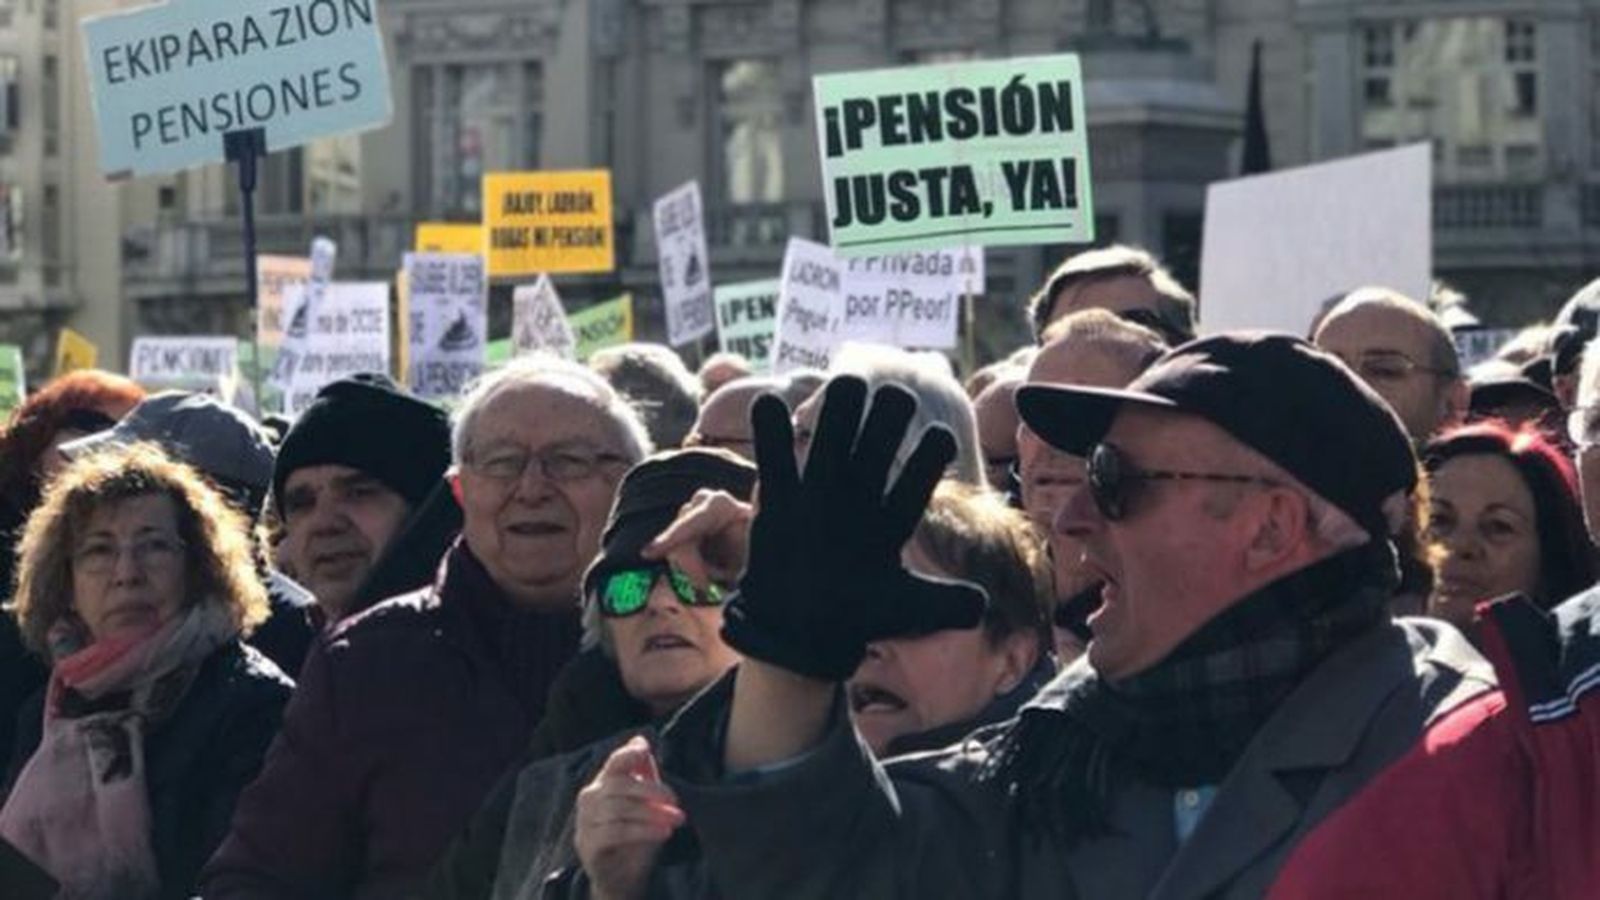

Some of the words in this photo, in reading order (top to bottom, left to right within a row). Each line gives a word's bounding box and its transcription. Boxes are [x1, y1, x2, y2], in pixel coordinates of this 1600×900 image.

[102, 0, 373, 84] EKIPARAZION
[131, 62, 361, 149] PENSIONES
[823, 73, 1075, 159] ¡PENSIÓN
[832, 164, 994, 228] JUSTA,
[1001, 157, 1079, 212] YA!
[720, 293, 780, 328] ¡PEN
[846, 293, 881, 323] por
